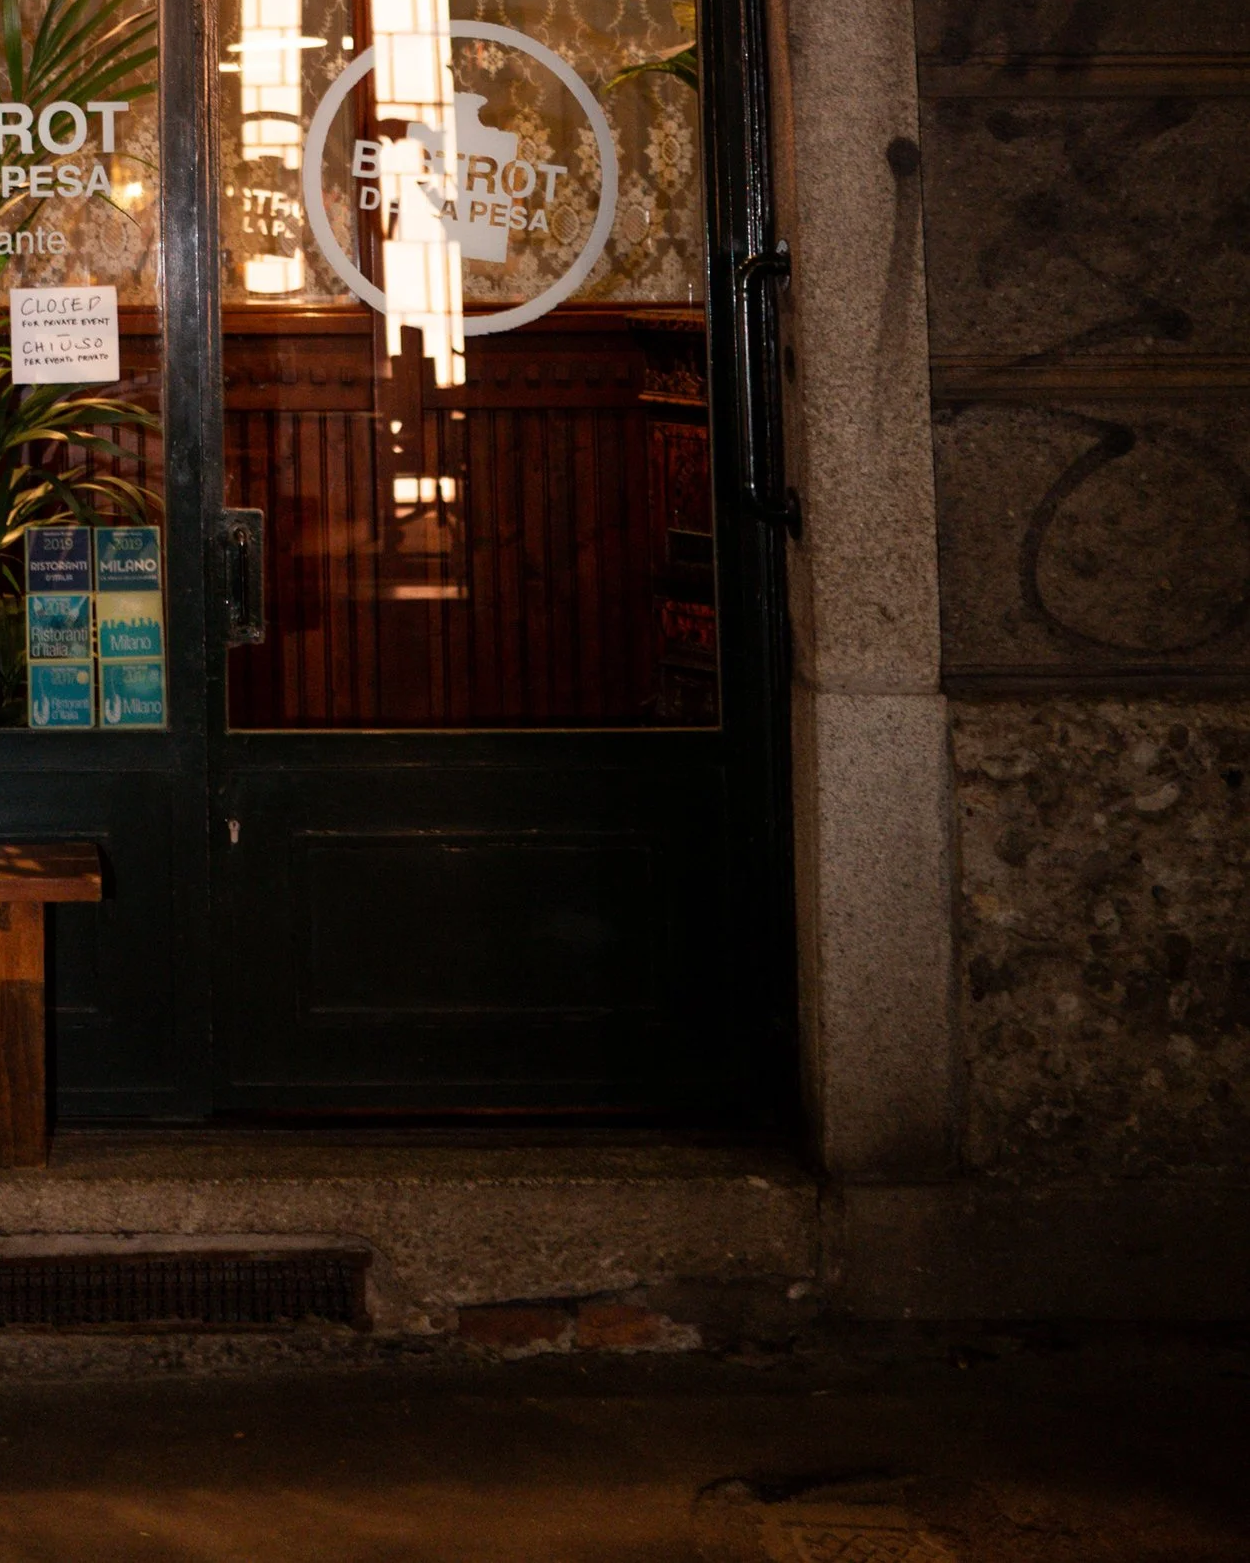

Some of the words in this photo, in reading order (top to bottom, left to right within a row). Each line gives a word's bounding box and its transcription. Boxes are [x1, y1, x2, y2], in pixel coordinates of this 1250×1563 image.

[1, 164, 112, 198] PESA
[468, 200, 549, 233] PESA
[20, 295, 101, 316] CLOSED
[22, 320, 39, 328] FOR
[44, 318, 78, 327] PRIVATE
[81, 317, 110, 326] EVENT
[22, 337, 103, 354] CHIUSO
[24, 357, 42, 366] PER
[100, 558, 157, 573] MILANO
[31, 627, 87, 642] Ristoranti
[110, 634, 151, 651] Milano
[123, 698, 162, 714] Milano
